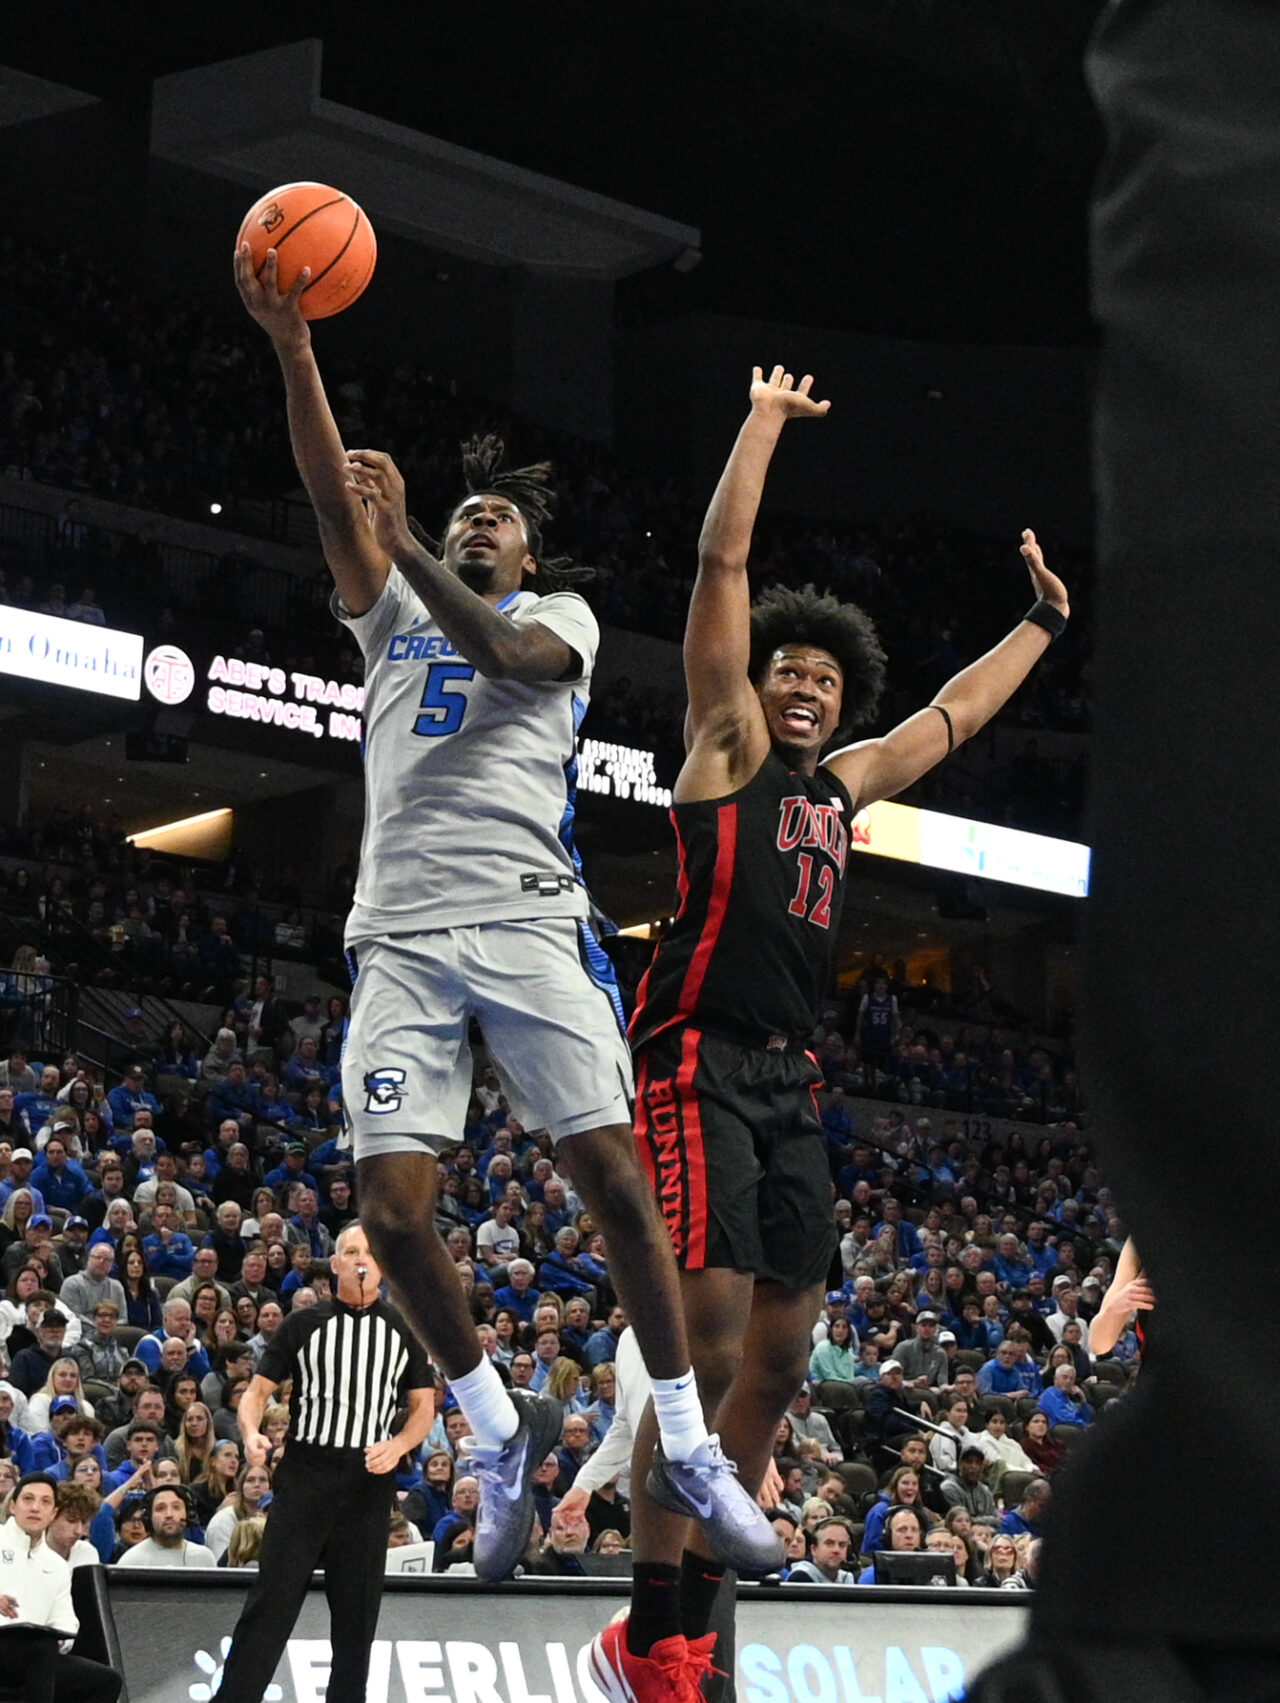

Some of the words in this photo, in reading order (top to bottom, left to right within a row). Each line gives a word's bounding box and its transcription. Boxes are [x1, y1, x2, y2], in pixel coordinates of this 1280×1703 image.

[28, 632, 136, 680] Omaha
[207, 655, 287, 696] ABE'S
[207, 686, 325, 738] SERVICE,
[410, 662, 476, 737] 5
[582, 738, 655, 768] ASSISTANCE
[615, 777, 631, 800] TO
[788, 851, 834, 930] 12
[961, 1119, 993, 1142] 123
[739, 1643, 966, 1703] SOLAR
